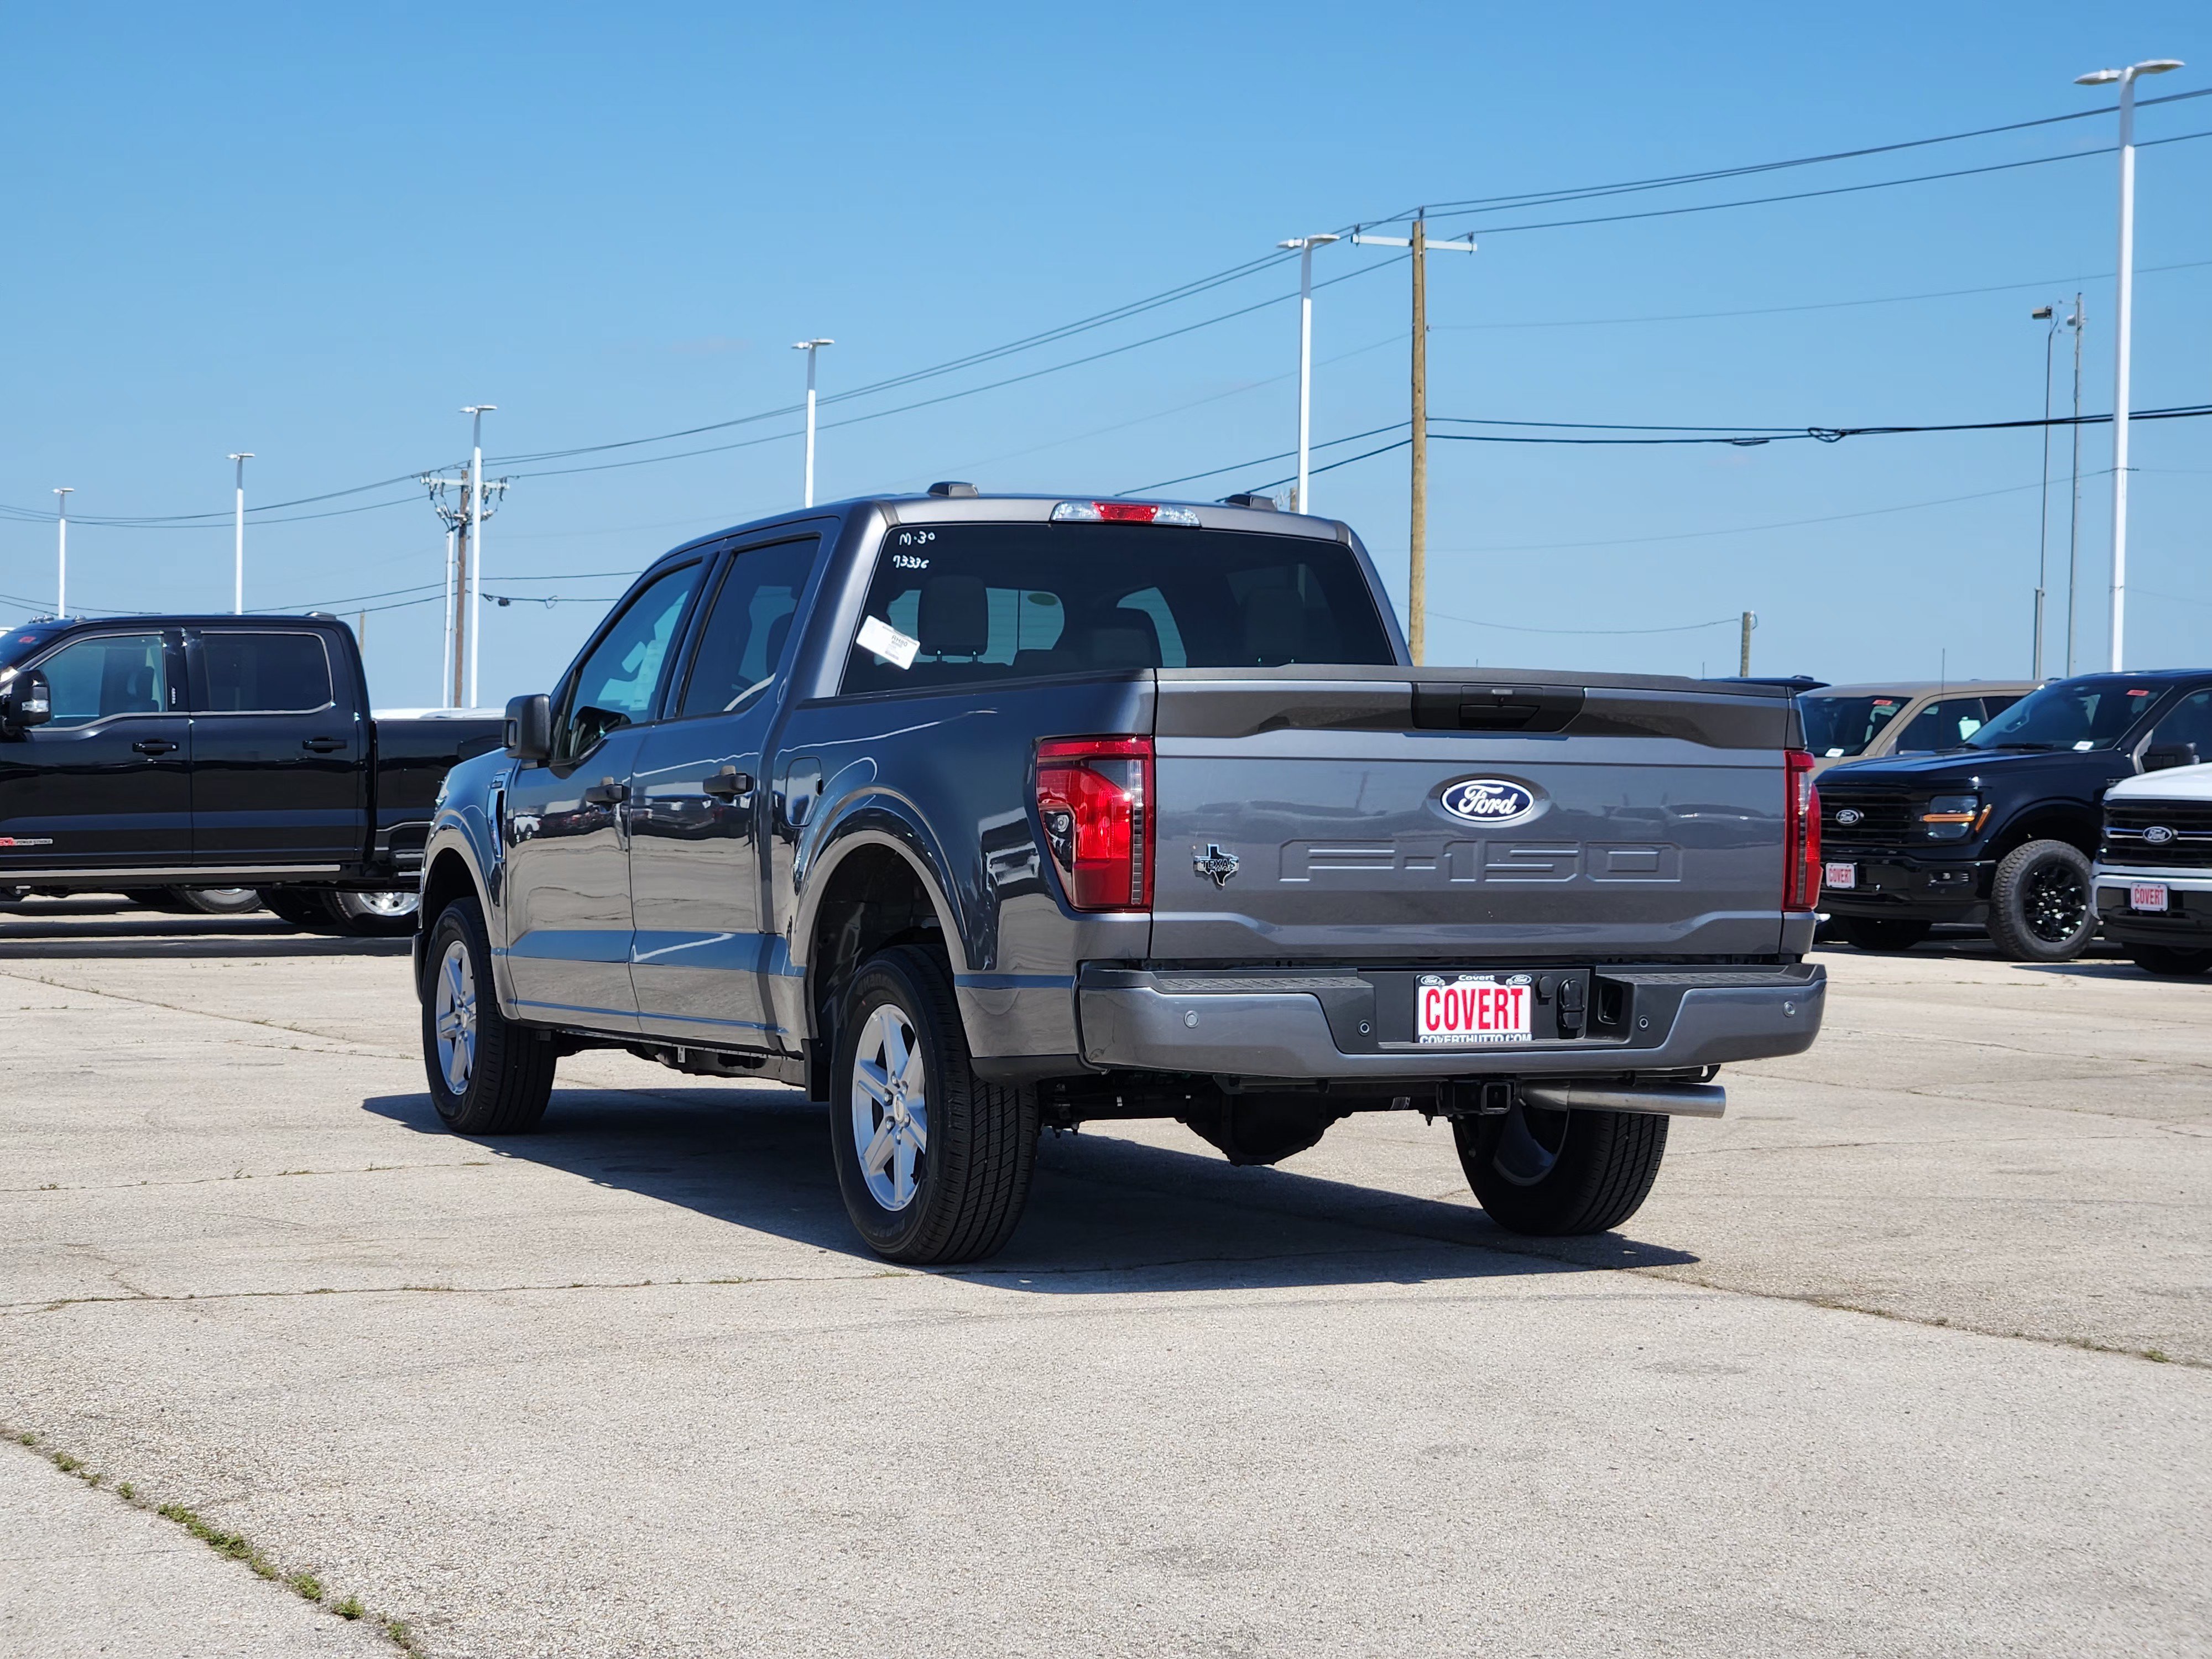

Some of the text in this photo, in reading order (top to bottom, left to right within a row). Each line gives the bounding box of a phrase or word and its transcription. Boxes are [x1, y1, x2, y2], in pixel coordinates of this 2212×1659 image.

[1458, 784, 1519, 815] Ford
[1199, 858, 1239, 869] TEXAS
[1279, 838, 1682, 883] F-150
[1829, 868, 1852, 883] COVERT
[2134, 888, 2164, 905] COVERT
[1426, 988, 1524, 1031] COVERT
